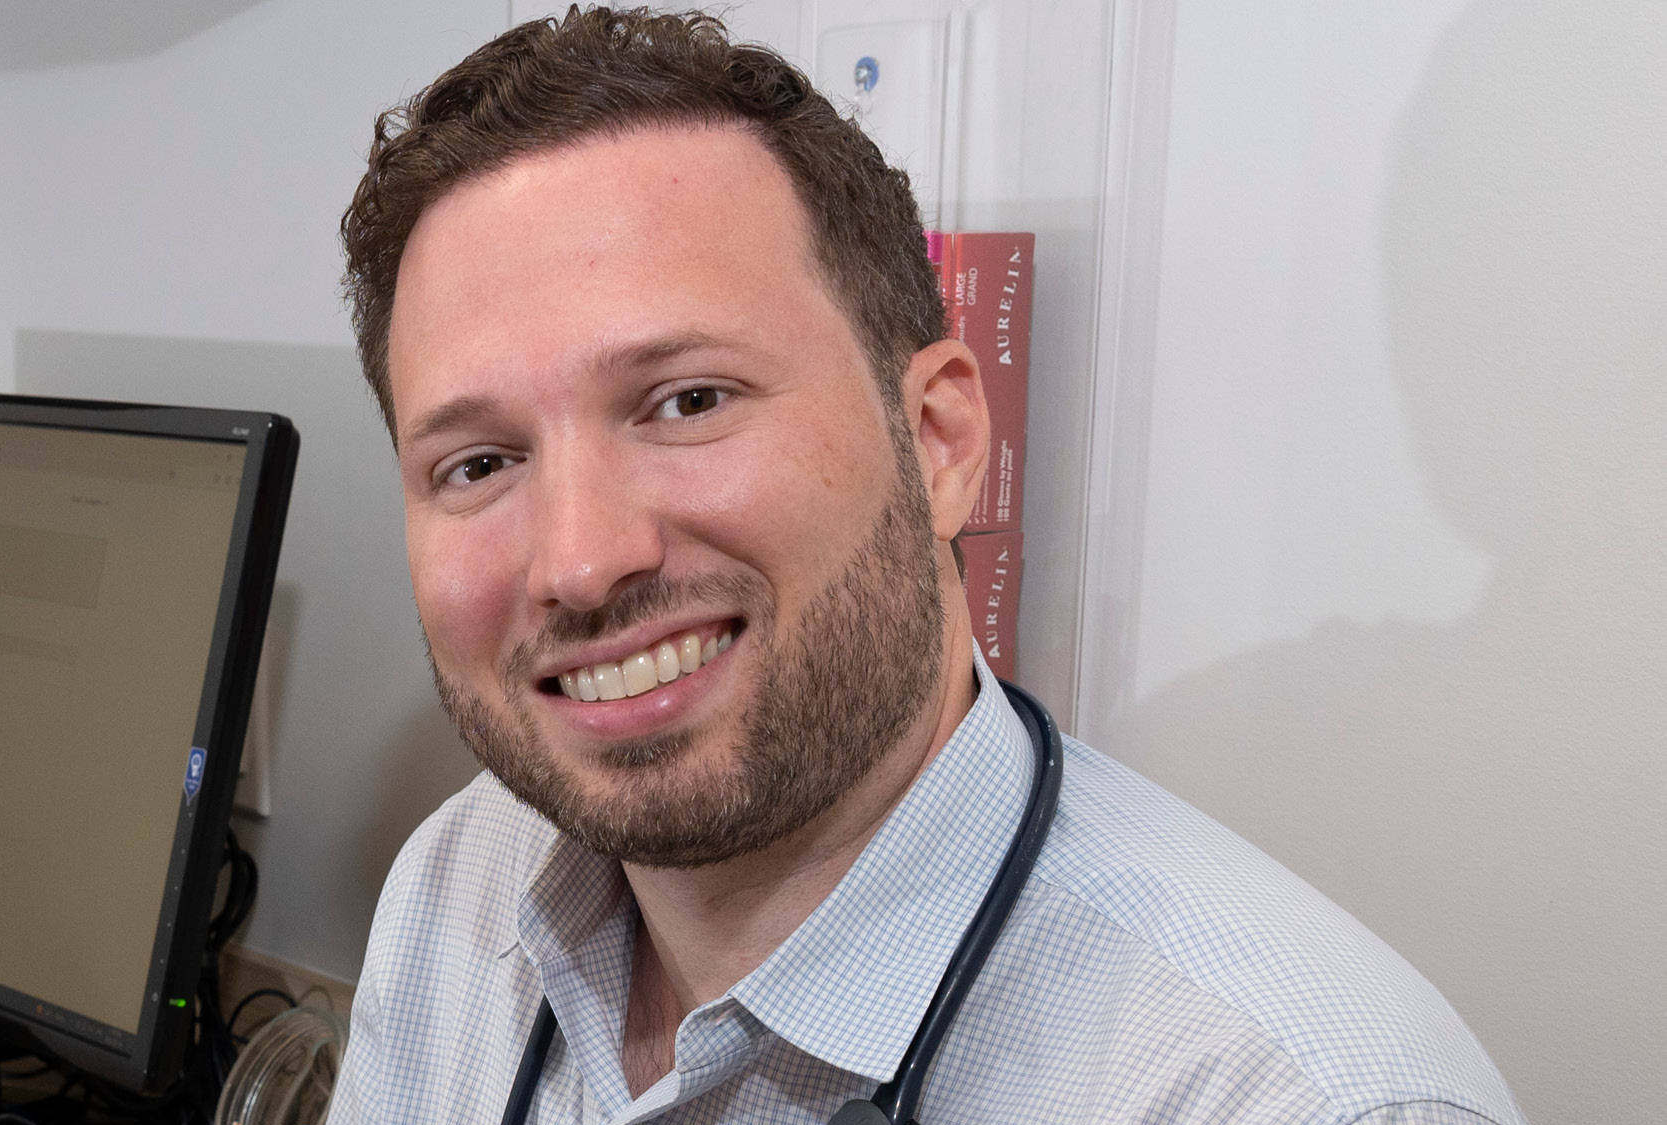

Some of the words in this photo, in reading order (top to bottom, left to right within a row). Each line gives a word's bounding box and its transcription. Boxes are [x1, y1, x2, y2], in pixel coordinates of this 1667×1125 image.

[955, 272, 967, 306] LARGE
[966, 267, 979, 306] GRAND
[997, 250, 1022, 365] AURELIA
[986, 550, 1009, 658] AURELIA
